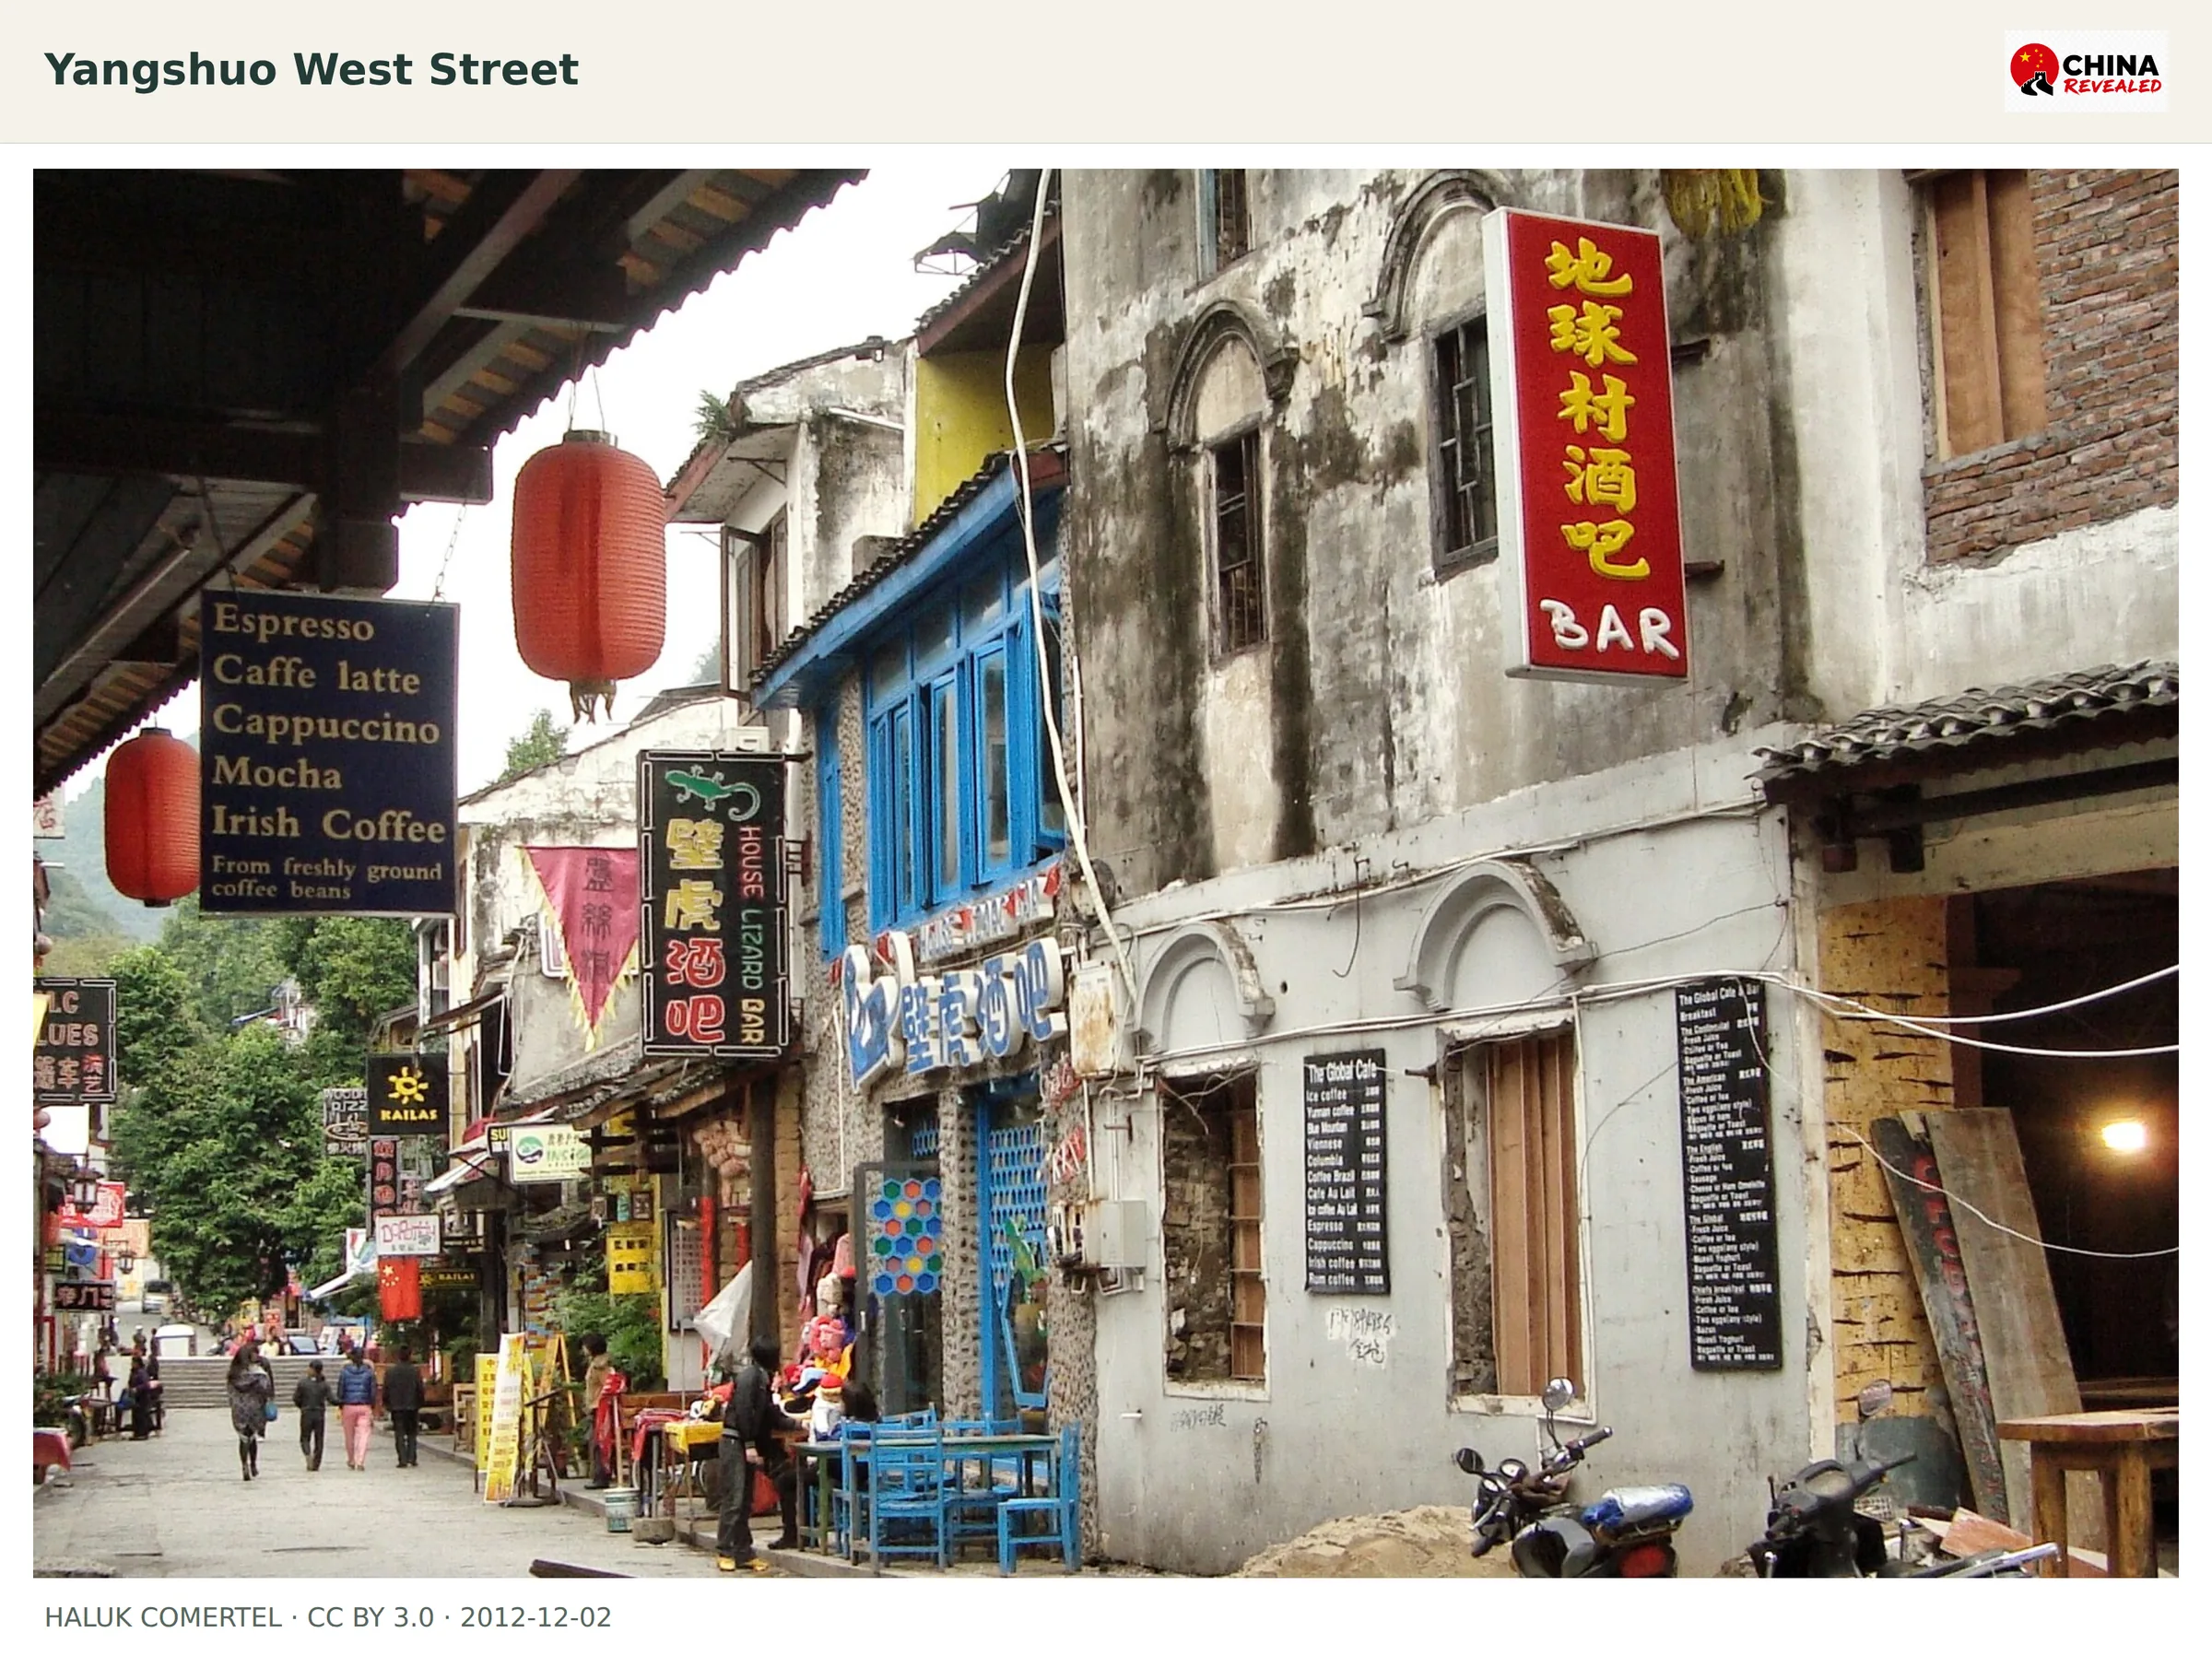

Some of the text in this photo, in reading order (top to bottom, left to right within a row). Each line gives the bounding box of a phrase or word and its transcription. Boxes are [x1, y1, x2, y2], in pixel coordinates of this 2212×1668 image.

[1545, 236, 1652, 581] 地球村酒吧
[213, 603, 374, 643] Espresso
[1539, 598, 1680, 661] BAR
[213, 654, 420, 695] Caffe latte
[213, 703, 440, 746] Cappuccino
[212, 755, 342, 789] Mocha
[212, 805, 446, 843] Irish Coffee
[212, 855, 441, 884] From freshly ground
[212, 879, 351, 899] coffee beans
[665, 817, 727, 1044] 壁虎酒吧
[739, 826, 766, 1045] HOUSE LIZARD BAR
[901, 937, 1064, 1075] 壁虎酒吧
[1309, 1058, 1377, 1083] The Global Cafe
[381, 1109, 438, 1122] KAILAS
[490, 1128, 510, 1141] SU
